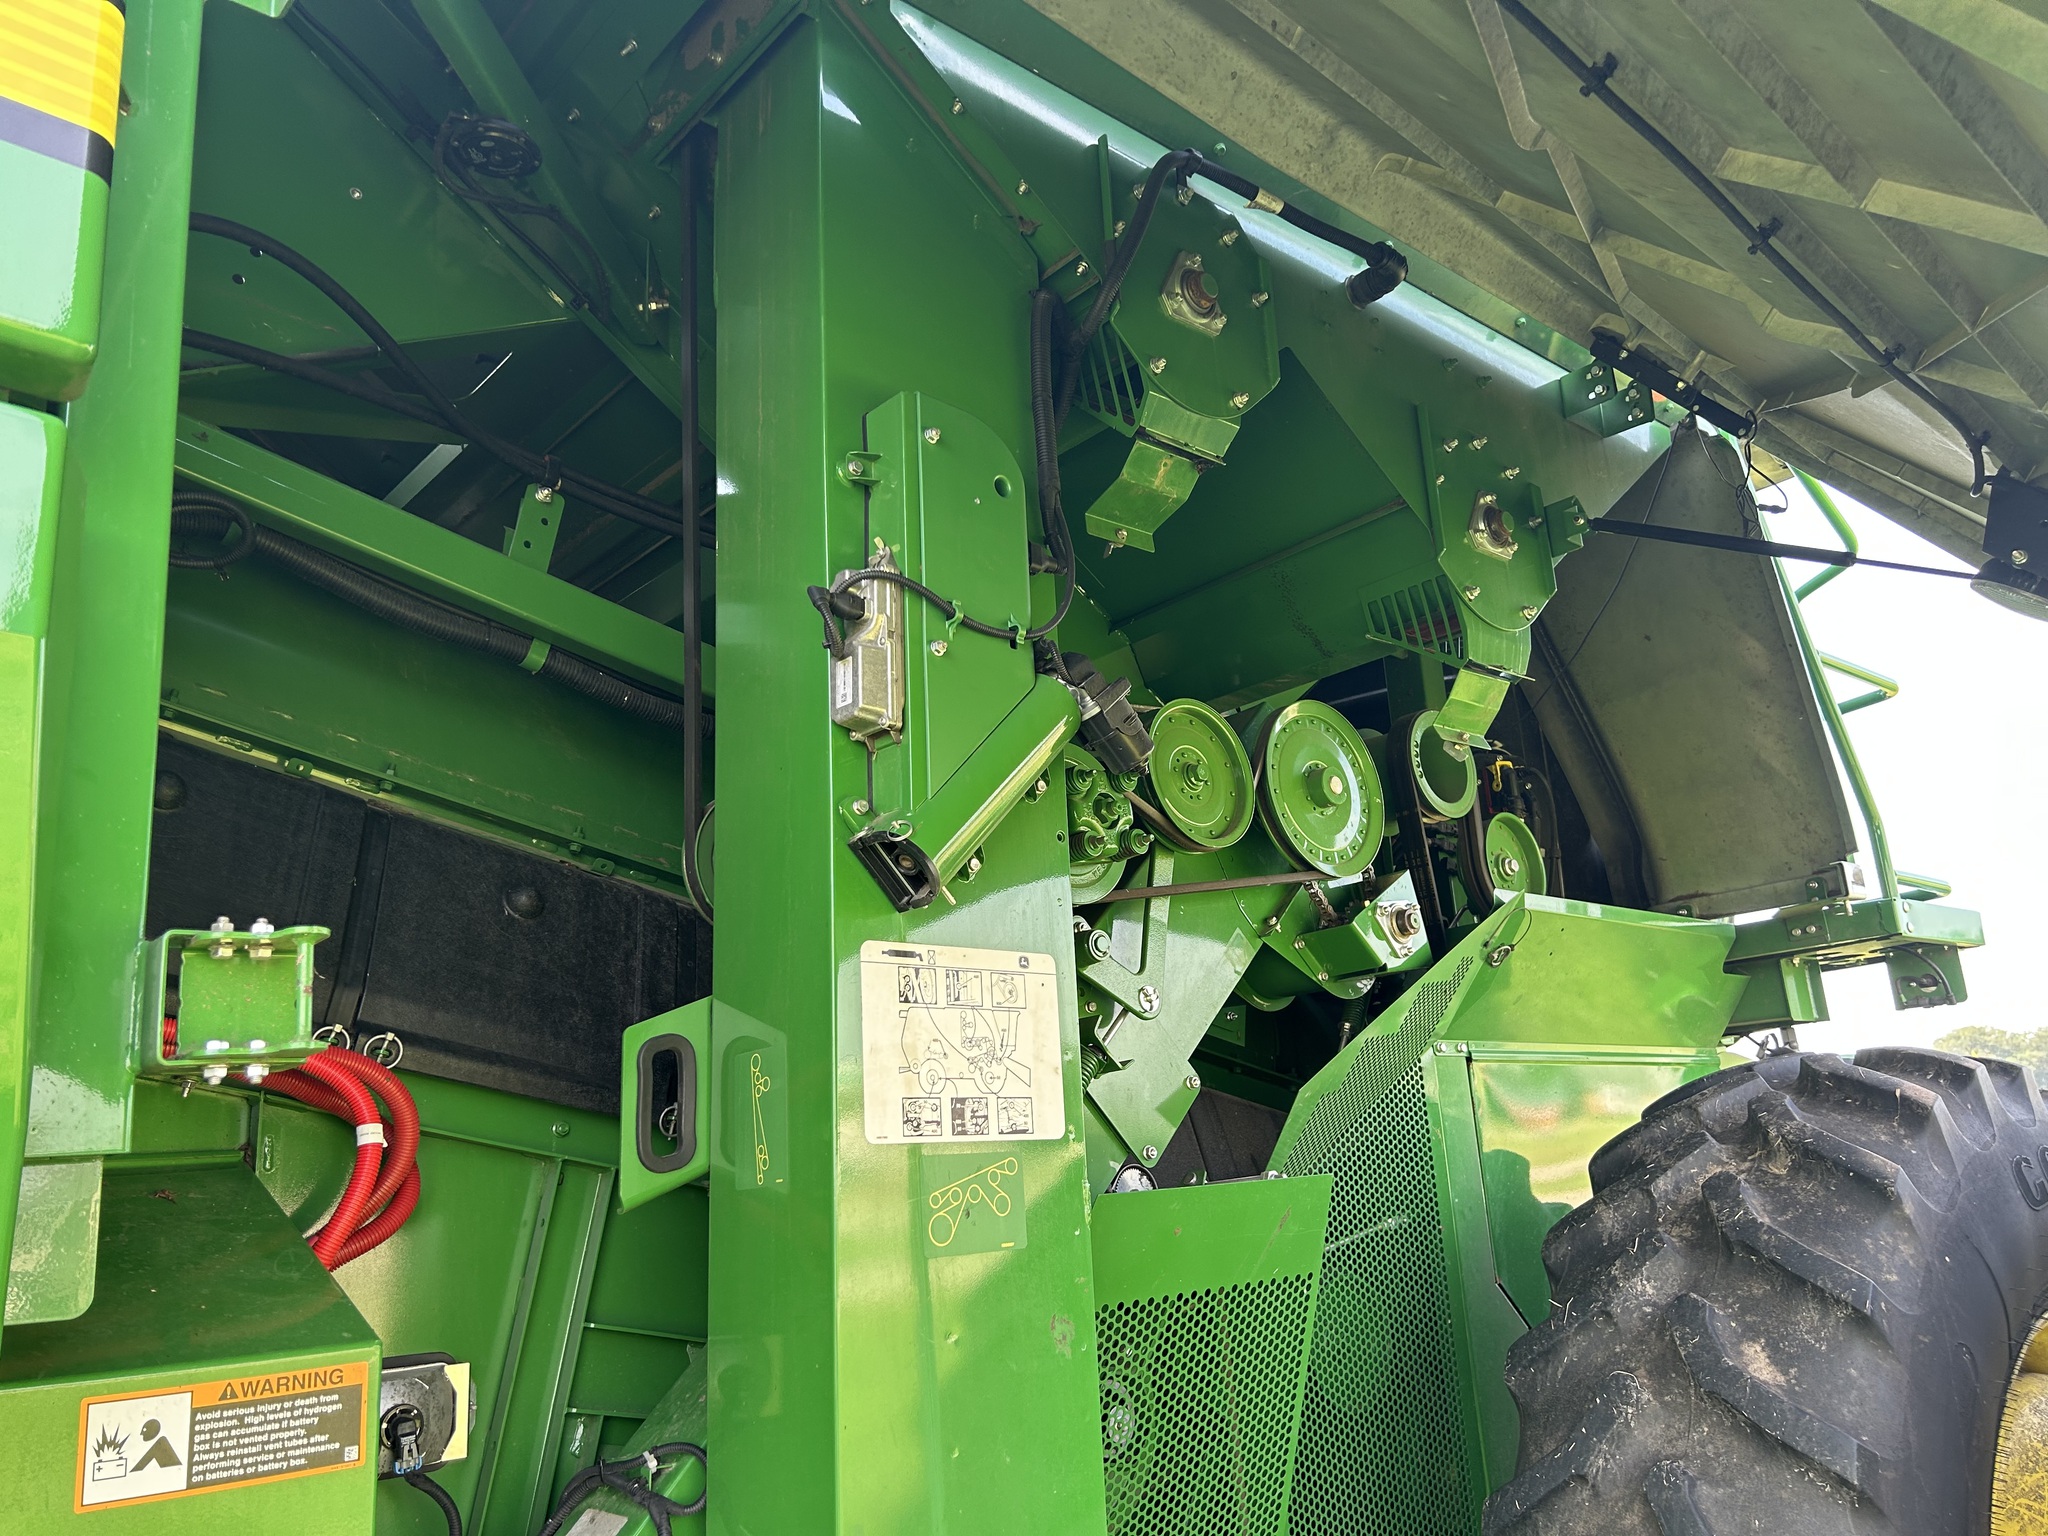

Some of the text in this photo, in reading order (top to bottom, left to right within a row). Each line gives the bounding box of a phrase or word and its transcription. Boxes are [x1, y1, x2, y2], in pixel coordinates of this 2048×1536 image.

[240, 1368, 344, 1398] WARNING
[195, 1404, 342, 1432] explosion. High levels of hydrogen
[196, 1411, 221, 1421] Avoid
[223, 1407, 255, 1418] serious
[258, 1404, 282, 1413] injury
[295, 1397, 318, 1407] death
[320, 1395, 339, 1403] from
[194, 1444, 210, 1452] box
[223, 1438, 238, 1448] not
[240, 1434, 269, 1445] vented
[271, 1429, 307, 1442] properly.
[195, 1434, 211, 1443] gas
[213, 1431, 229, 1439] can
[231, 1423, 280, 1436] accumulate
[290, 1417, 319, 1427] battery
[193, 1435, 330, 1462] Always reinstall vent tubes after
[193, 1459, 241, 1474] performing
[244, 1454, 275, 1465] service
[288, 1443, 340, 1457] maintenance
[192, 1475, 204, 1483] on
[206, 1469, 245, 1481] batteries
[258, 1462, 288, 1472] battery
[290, 1459, 308, 1467] box.
